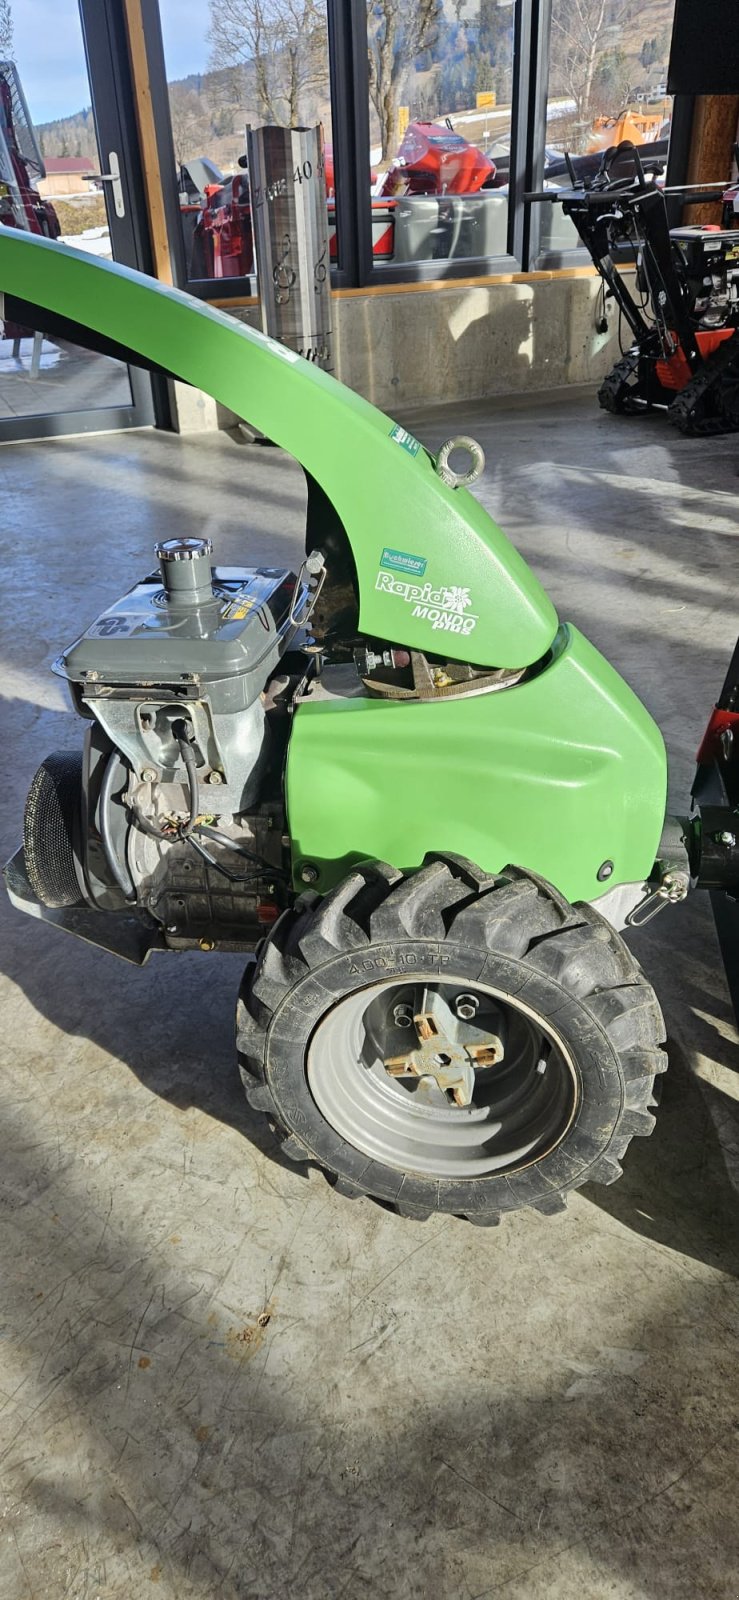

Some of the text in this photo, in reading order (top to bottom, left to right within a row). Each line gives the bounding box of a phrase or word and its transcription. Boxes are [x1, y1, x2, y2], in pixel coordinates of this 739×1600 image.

[293, 160, 312, 184] 40
[375, 571, 448, 606] Rapid
[411, 605, 476, 631] MONDO
[432, 620, 471, 635] plus
